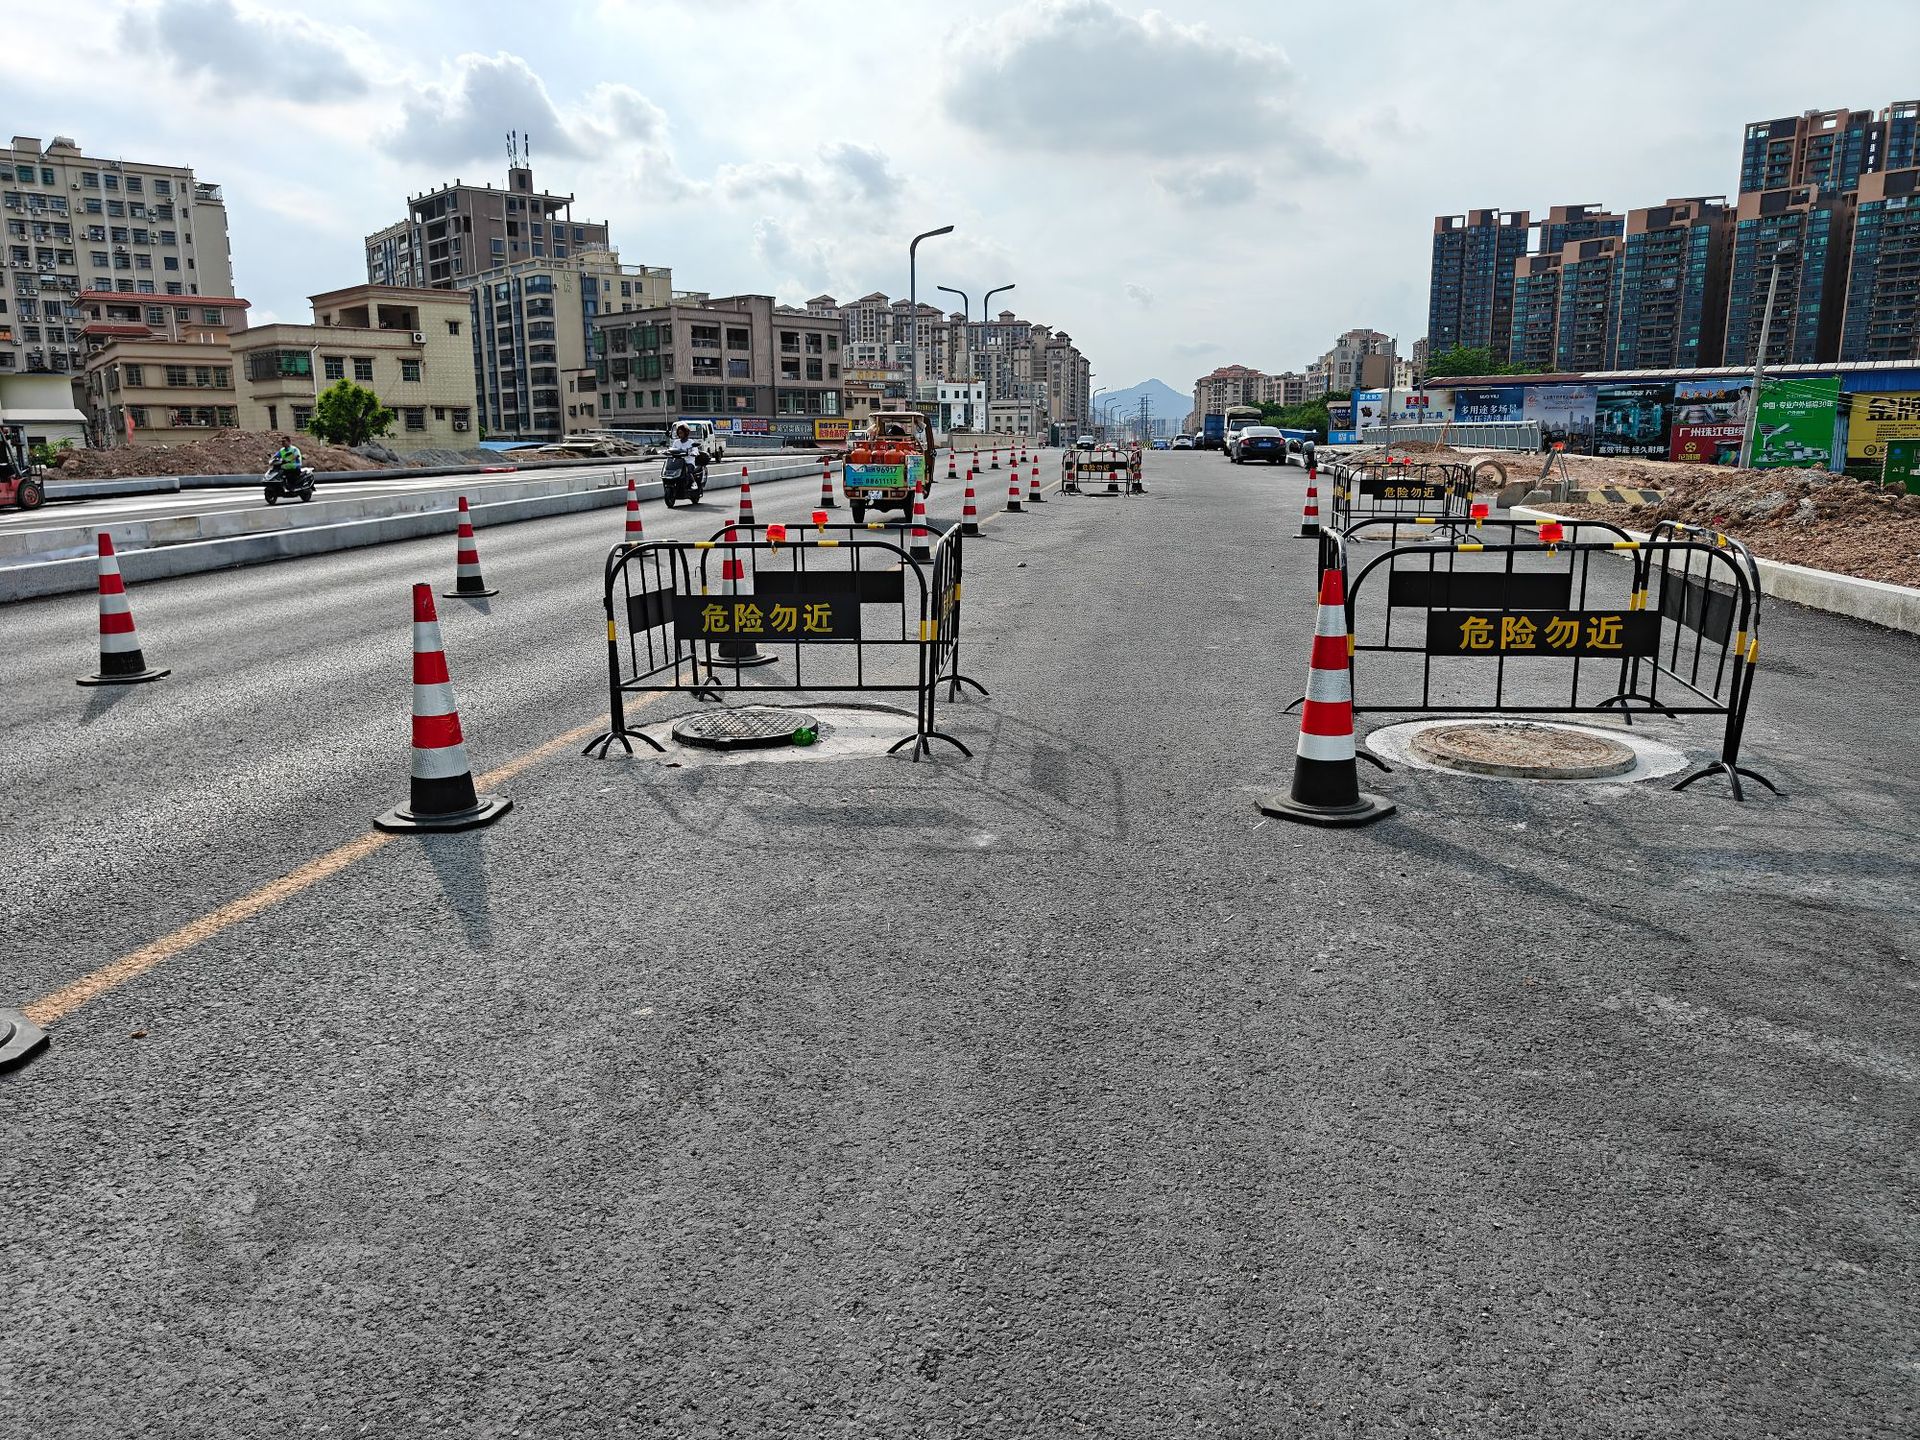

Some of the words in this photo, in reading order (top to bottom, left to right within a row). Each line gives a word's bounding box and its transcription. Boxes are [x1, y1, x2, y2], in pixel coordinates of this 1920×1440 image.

[1460, 404, 1518, 416] 多用途多场景
[1679, 427, 1746, 437] 广州珠江电缆
[1599, 446, 1630, 454] 高效节能
[1631, 446, 1665, 454] 经久耐用
[1384, 487, 1435, 498] 危险勿近
[701, 603, 833, 633] 危险勿近
[1459, 616, 1623, 649] 危险勿近
